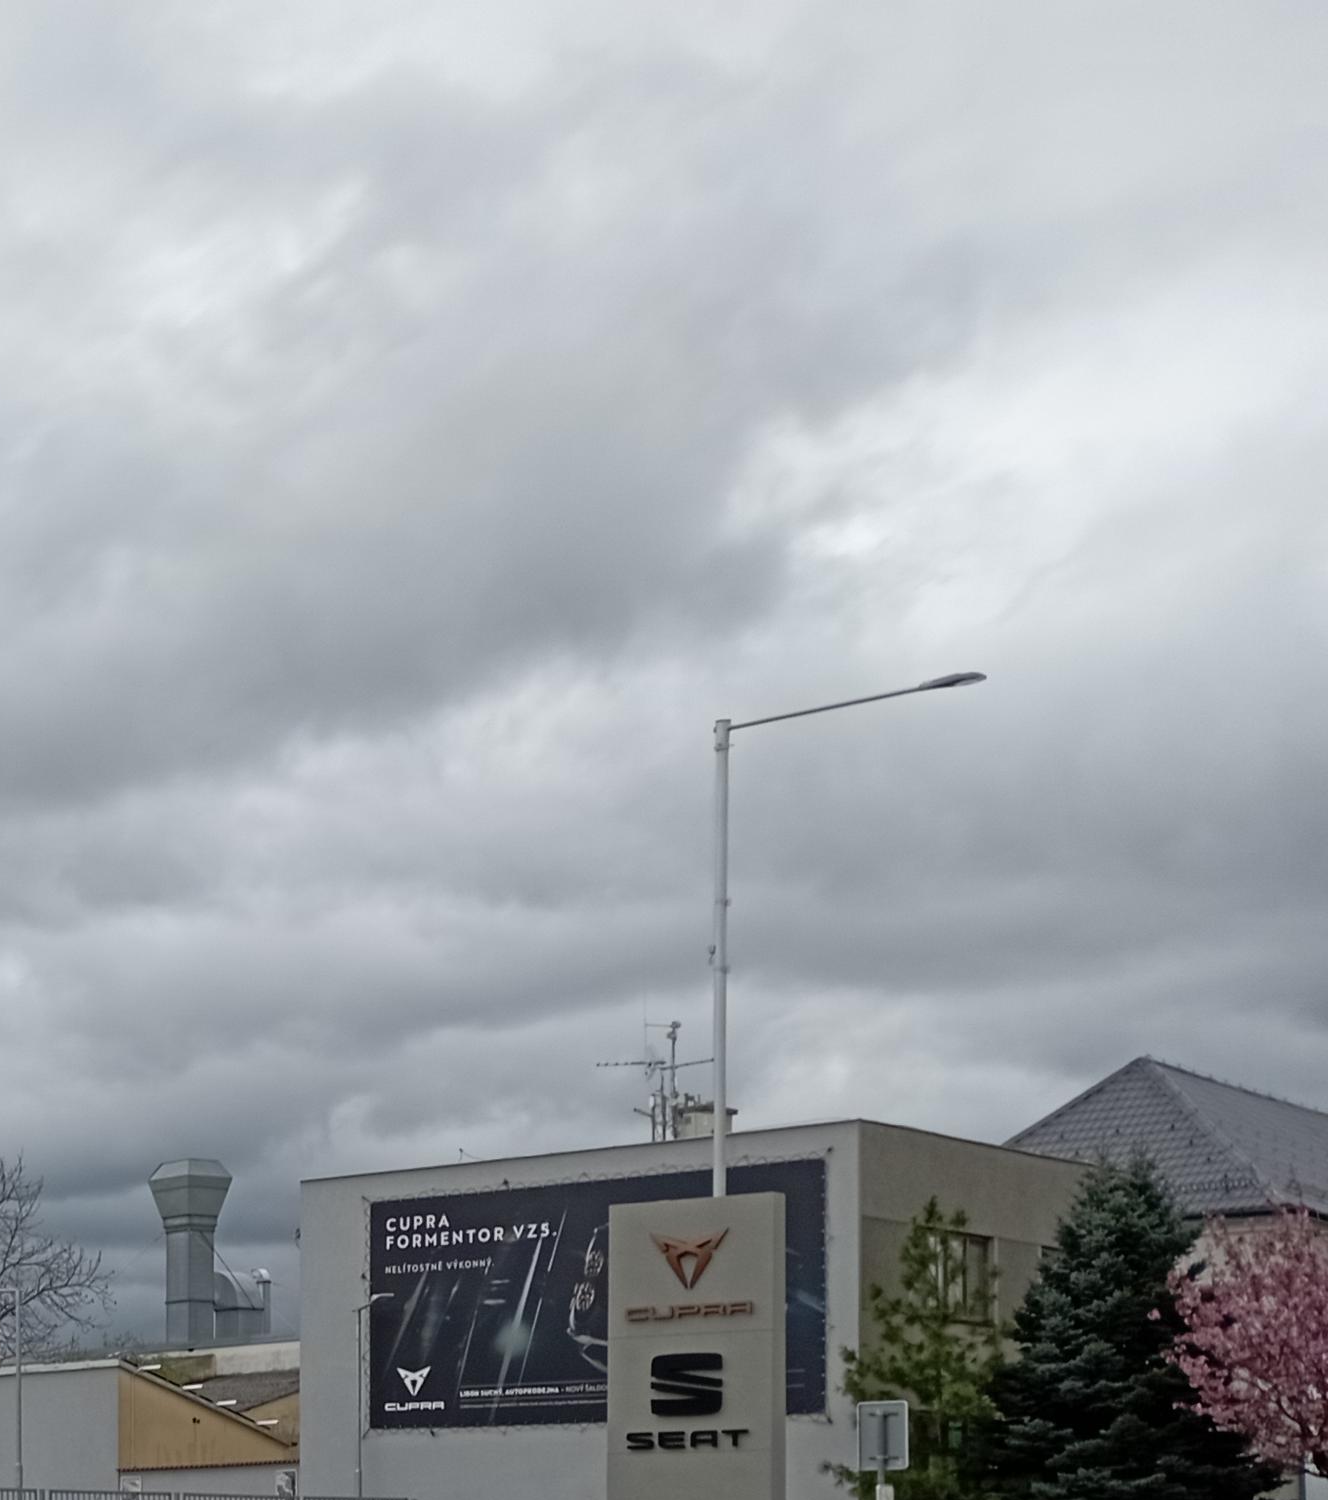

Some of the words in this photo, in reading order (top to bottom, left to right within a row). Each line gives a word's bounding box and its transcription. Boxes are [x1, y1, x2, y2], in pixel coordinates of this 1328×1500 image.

[386, 1214, 450, 1232] CUPRA
[386, 1226, 504, 1250] FORMENTOR
[626, 1301, 754, 1322] CUPRA
[384, 1401, 444, 1411] CUPRA
[626, 1429, 749, 1450] SEAT
